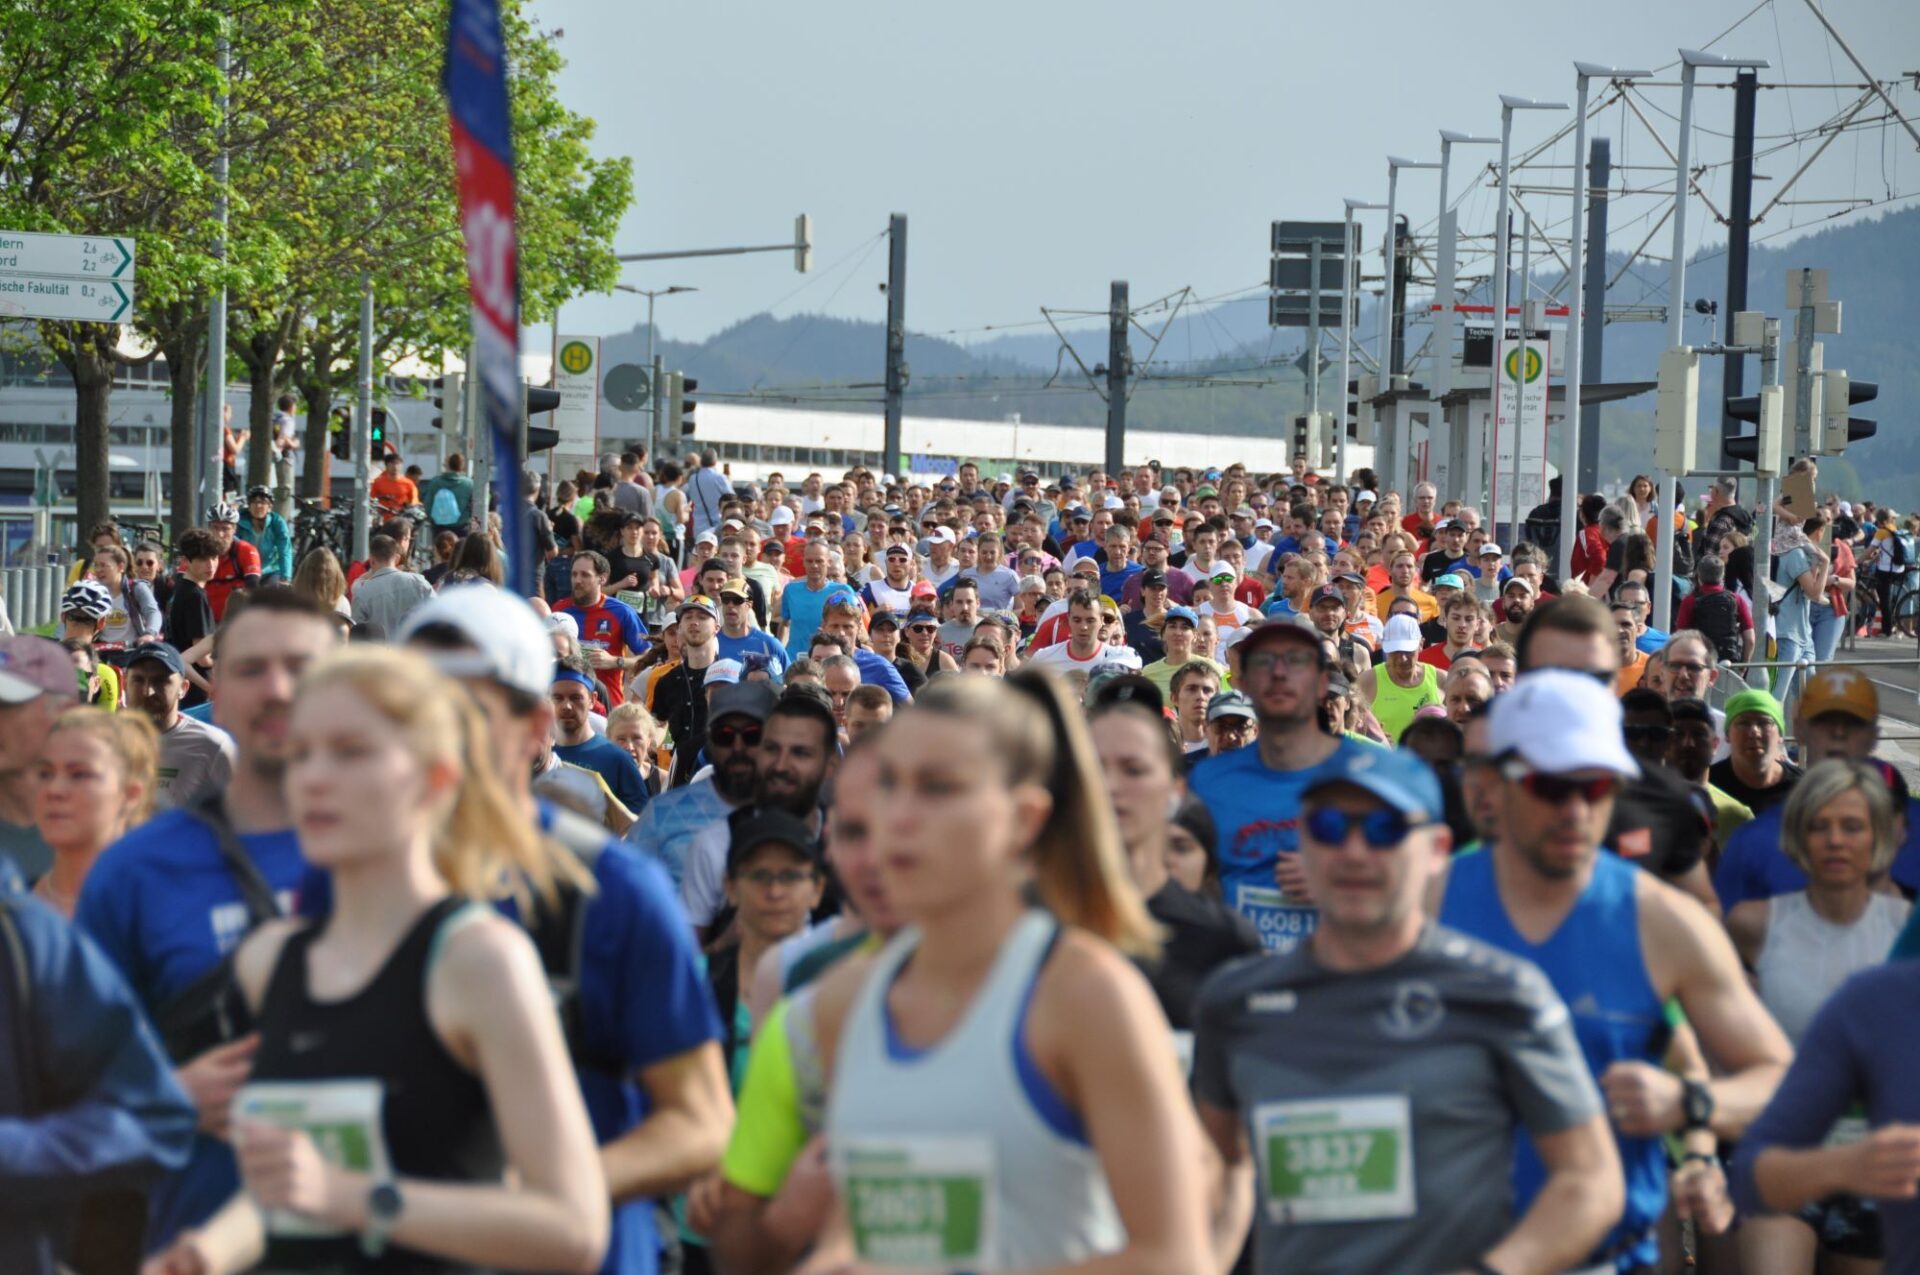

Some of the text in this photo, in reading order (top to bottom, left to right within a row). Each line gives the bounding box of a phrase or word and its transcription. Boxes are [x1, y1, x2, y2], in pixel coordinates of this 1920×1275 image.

[83, 259, 97, 272] 2,2
[28, 281, 69, 296] Fakultät
[82, 285, 96, 298] 0,2
[1249, 909, 1314, 935] 16081
